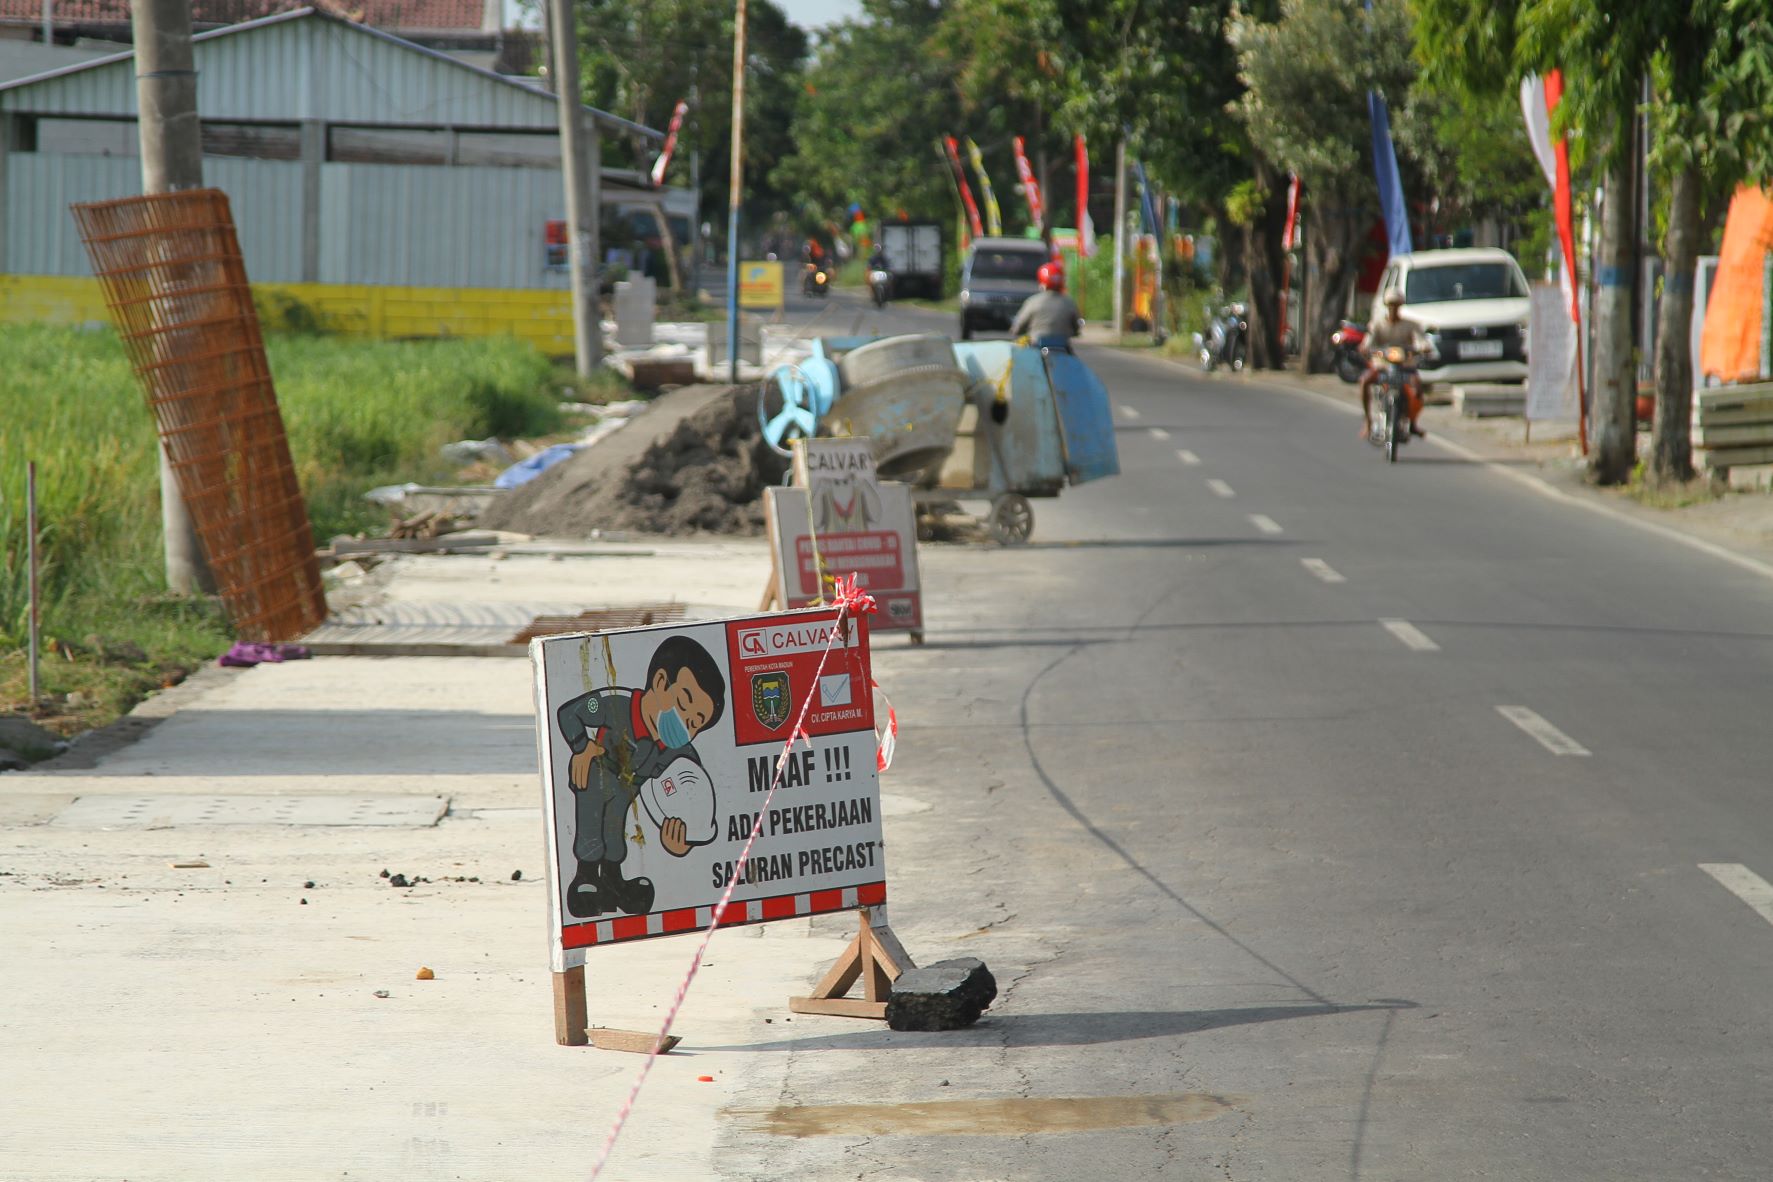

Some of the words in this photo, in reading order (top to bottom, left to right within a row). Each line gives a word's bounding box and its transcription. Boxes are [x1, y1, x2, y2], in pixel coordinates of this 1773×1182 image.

[820, 711, 837, 722] CIPTA
[837, 709, 856, 720] KARYA
[747, 750, 815, 792] MAAF
[824, 746, 851, 783] !!!
[727, 812, 764, 842] ADA
[769, 797, 872, 836] PEKERJAAN
[712, 853, 793, 888] SALURAN
[799, 841, 875, 877] PRECAST
